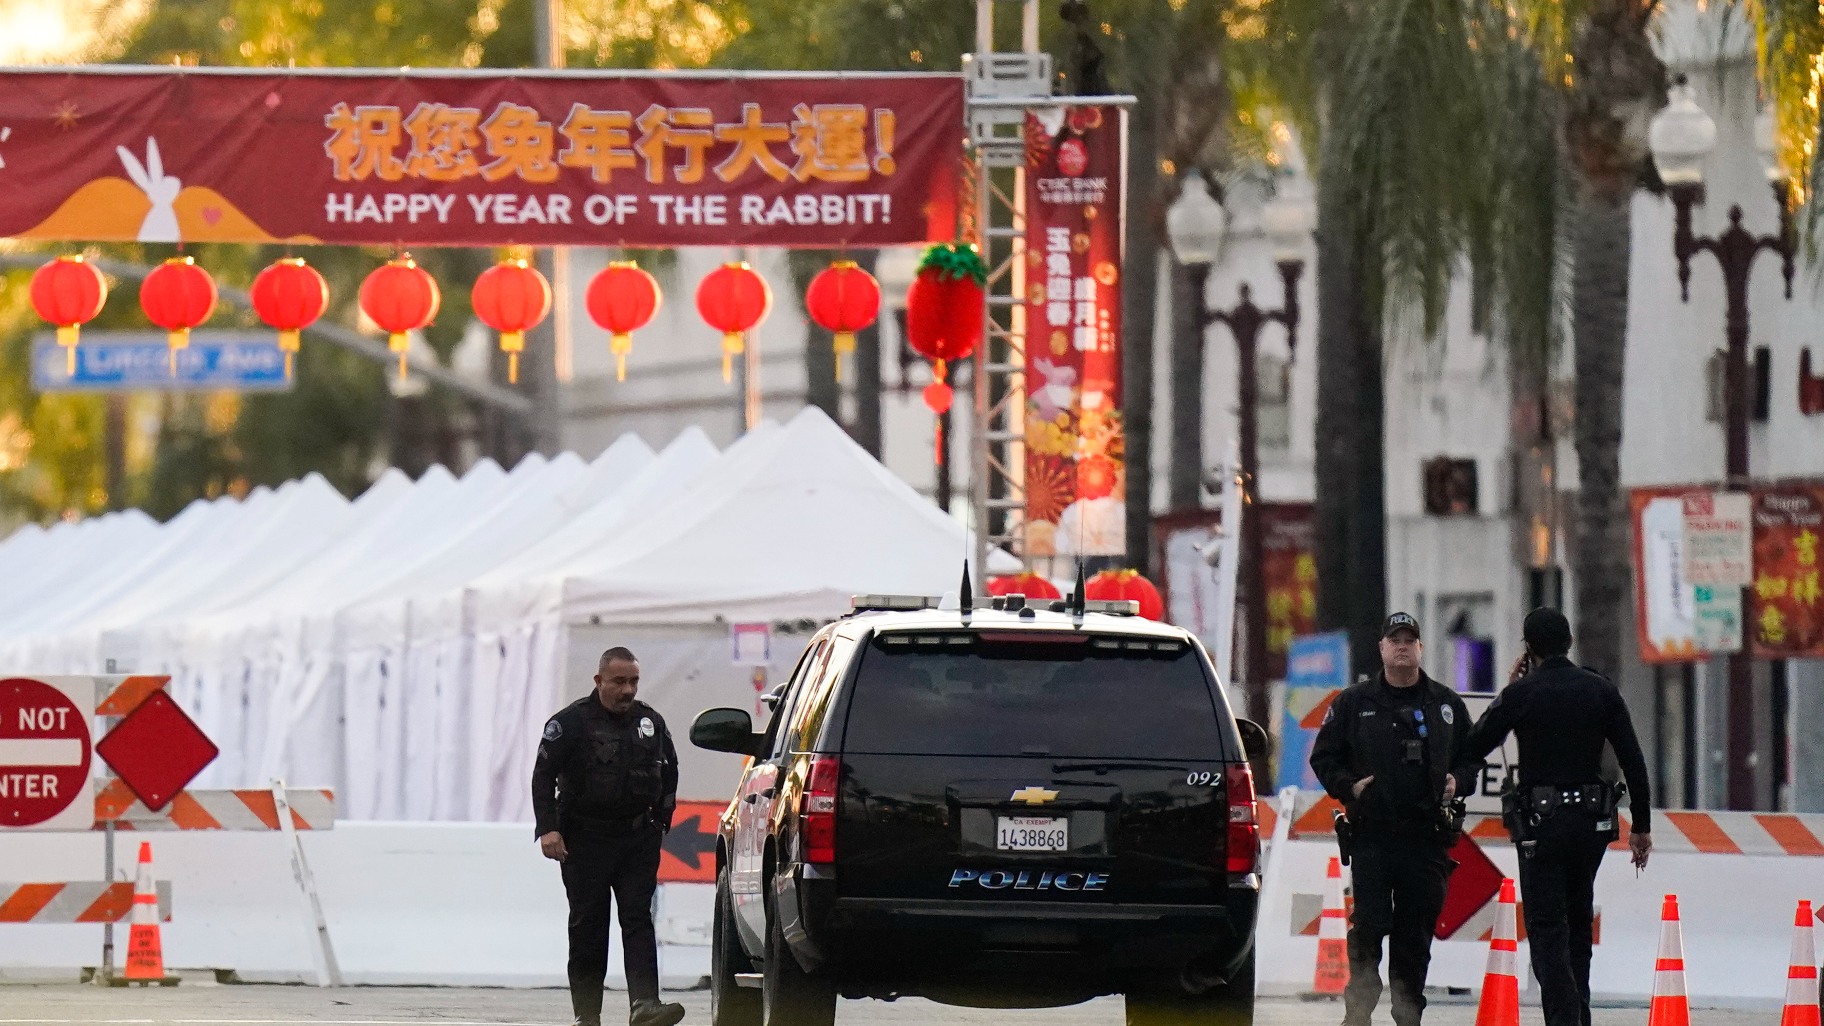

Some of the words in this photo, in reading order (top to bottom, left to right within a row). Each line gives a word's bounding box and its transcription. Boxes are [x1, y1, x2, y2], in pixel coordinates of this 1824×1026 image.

[323, 101, 896, 184] 祝您兔年行大運!
[325, 193, 456, 224] HAPPY
[467, 194, 572, 225] YEAR
[583, 194, 638, 225] OF
[649, 194, 728, 225] THE
[740, 194, 891, 225] RABBIT!
[18, 707, 70, 730] NOT
[1186, 771, 1222, 787] 092
[1001, 828, 1065, 848] 1438868
[948, 868, 1111, 891] POLICE
